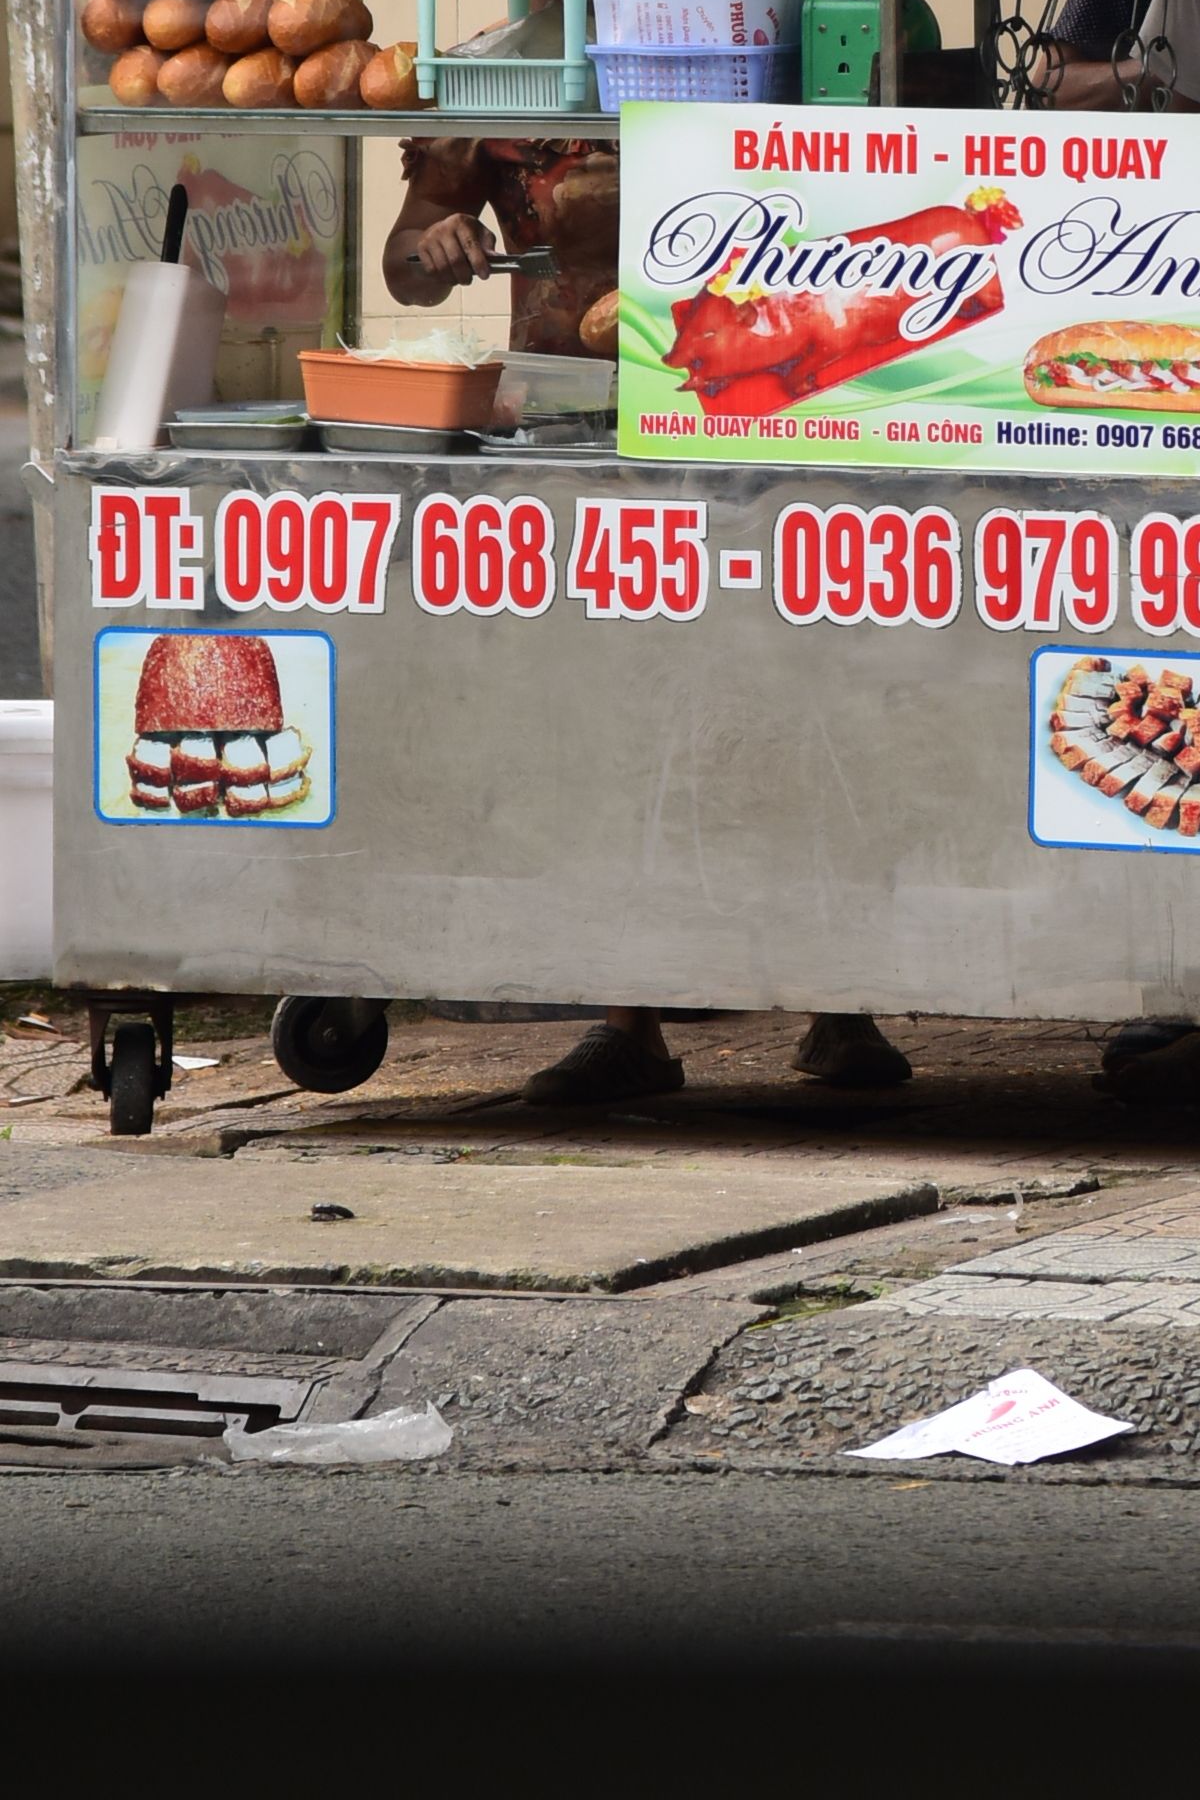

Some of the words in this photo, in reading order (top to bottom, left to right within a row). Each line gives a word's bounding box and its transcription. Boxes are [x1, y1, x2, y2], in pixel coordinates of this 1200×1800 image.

[734, 122, 850, 173] BÁNH
[866, 124, 918, 174] MÌ
[964, 135, 1047, 178] HEO
[1062, 137, 1168, 183] QUAY
[643, 191, 992, 335] Phương
[640, 412, 696, 440] NHẬN
[703, 415, 752, 438] QUAY
[758, 417, 797, 439] HEO
[804, 415, 859, 440] CÚNG
[886, 421, 920, 442] GIA
[927, 418, 983, 444] CÔNG
[997, 420, 1088, 447] Hotline:
[1096, 424, 1154, 448] 0907
[98, 495, 194, 600] ĐT:
[224, 499, 391, 605] 0907
[421, 502, 547, 609] 668
[576, 507, 701, 612] 455
[781, 511, 954, 621] 0936
[982, 516, 1111, 624] 979
